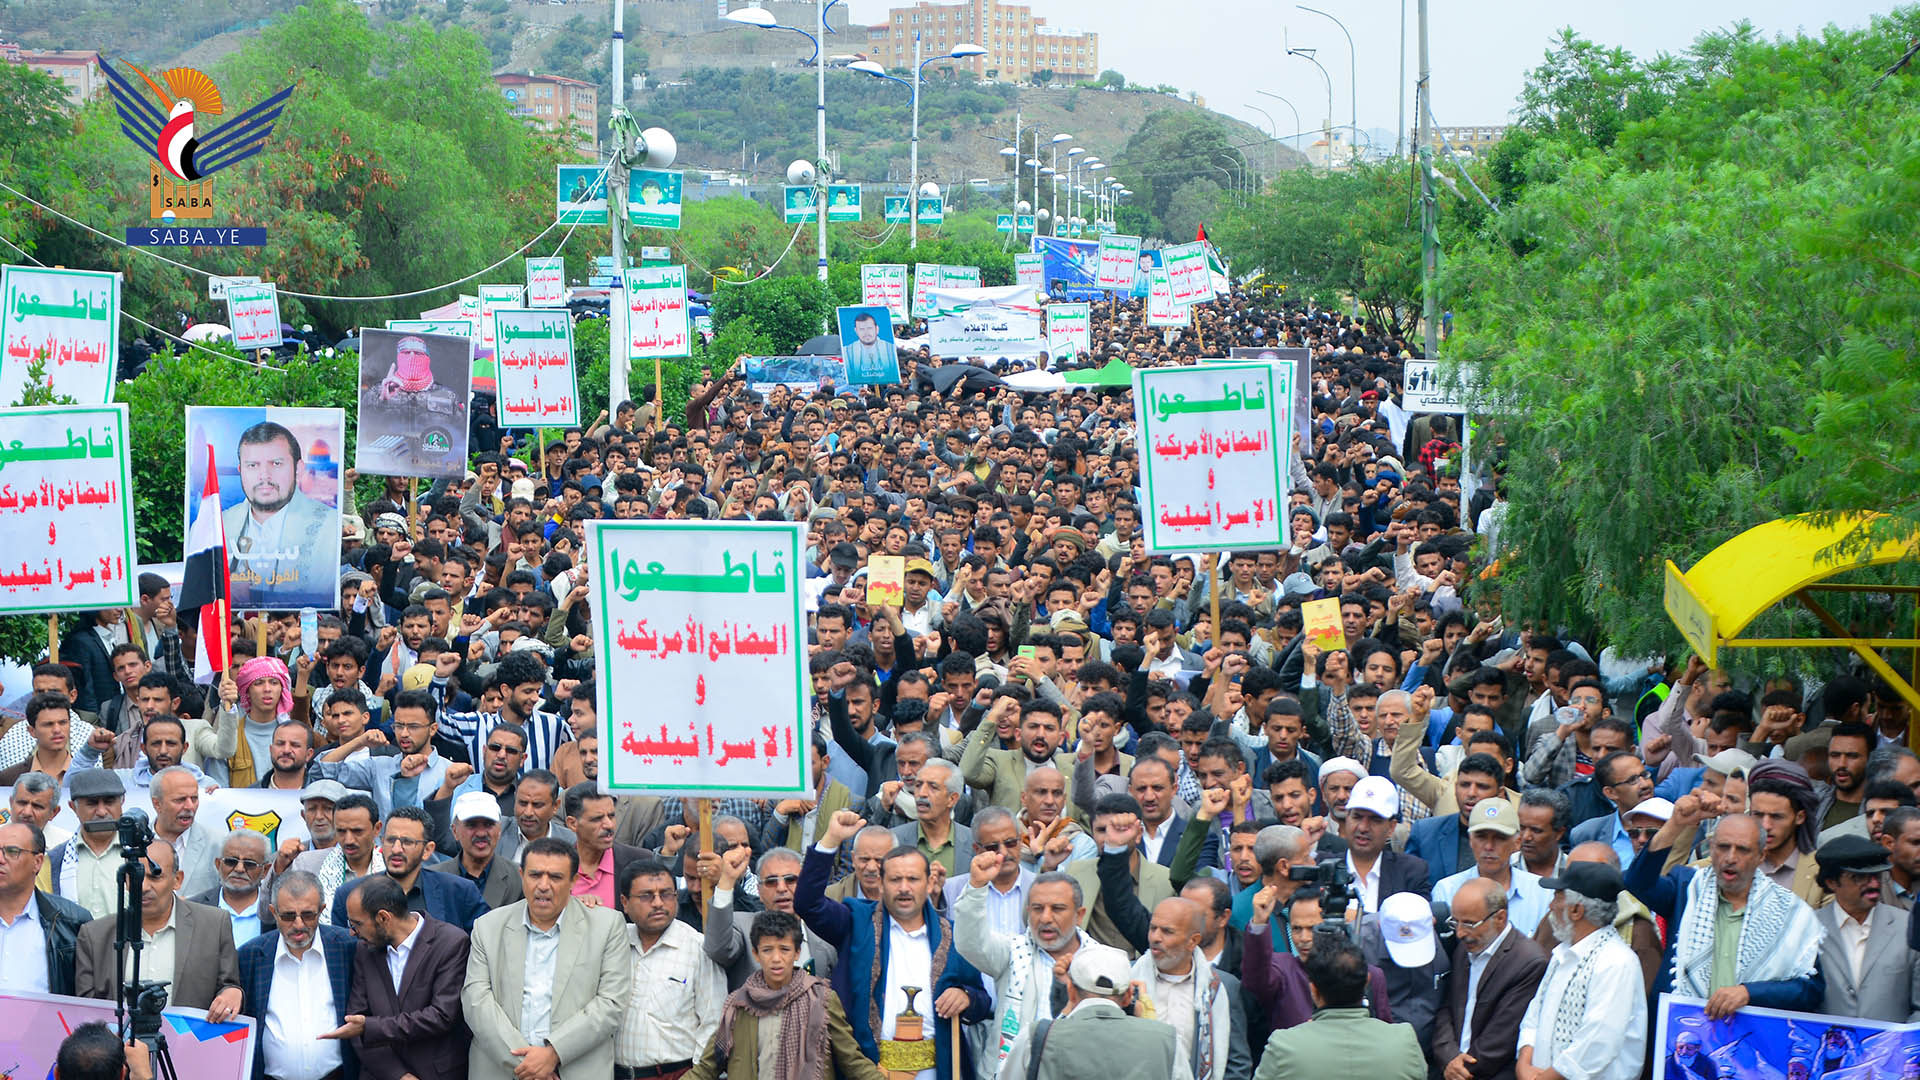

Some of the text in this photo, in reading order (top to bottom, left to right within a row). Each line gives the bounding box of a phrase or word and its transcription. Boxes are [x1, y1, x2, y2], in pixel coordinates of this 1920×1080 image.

[628, 271, 683, 295] قاطعوا
[11, 284, 107, 323] قاطعوا
[659, 296, 684, 313] البضائع
[500, 319, 567, 345] قاطعوا
[632, 332, 686, 350] الإسرائيلية
[8, 331, 106, 369] البضائع الأمريكية
[502, 346, 568, 371] البضائع الأمريكية
[533, 373, 538, 389] و
[505, 395, 572, 417] الإسرائيلية
[1149, 381, 1265, 423] قاطعوا
[1155, 427, 1268, 461] البضائع الأمريكية
[1207, 467, 1215, 490] و
[57, 479, 117, 512] البضائع
[1159, 498, 1274, 532] الإسرائيلية
[48, 521, 57, 546] و
[0, 555, 123, 592] الإسرائيلي
[265, 567, 299, 585] القول
[611, 547, 786, 602] قاطعوا
[617, 614, 787, 663] البضائع الأمريكية
[695, 673, 706, 706] و
[620, 721, 793, 767] الإسرائيلية
